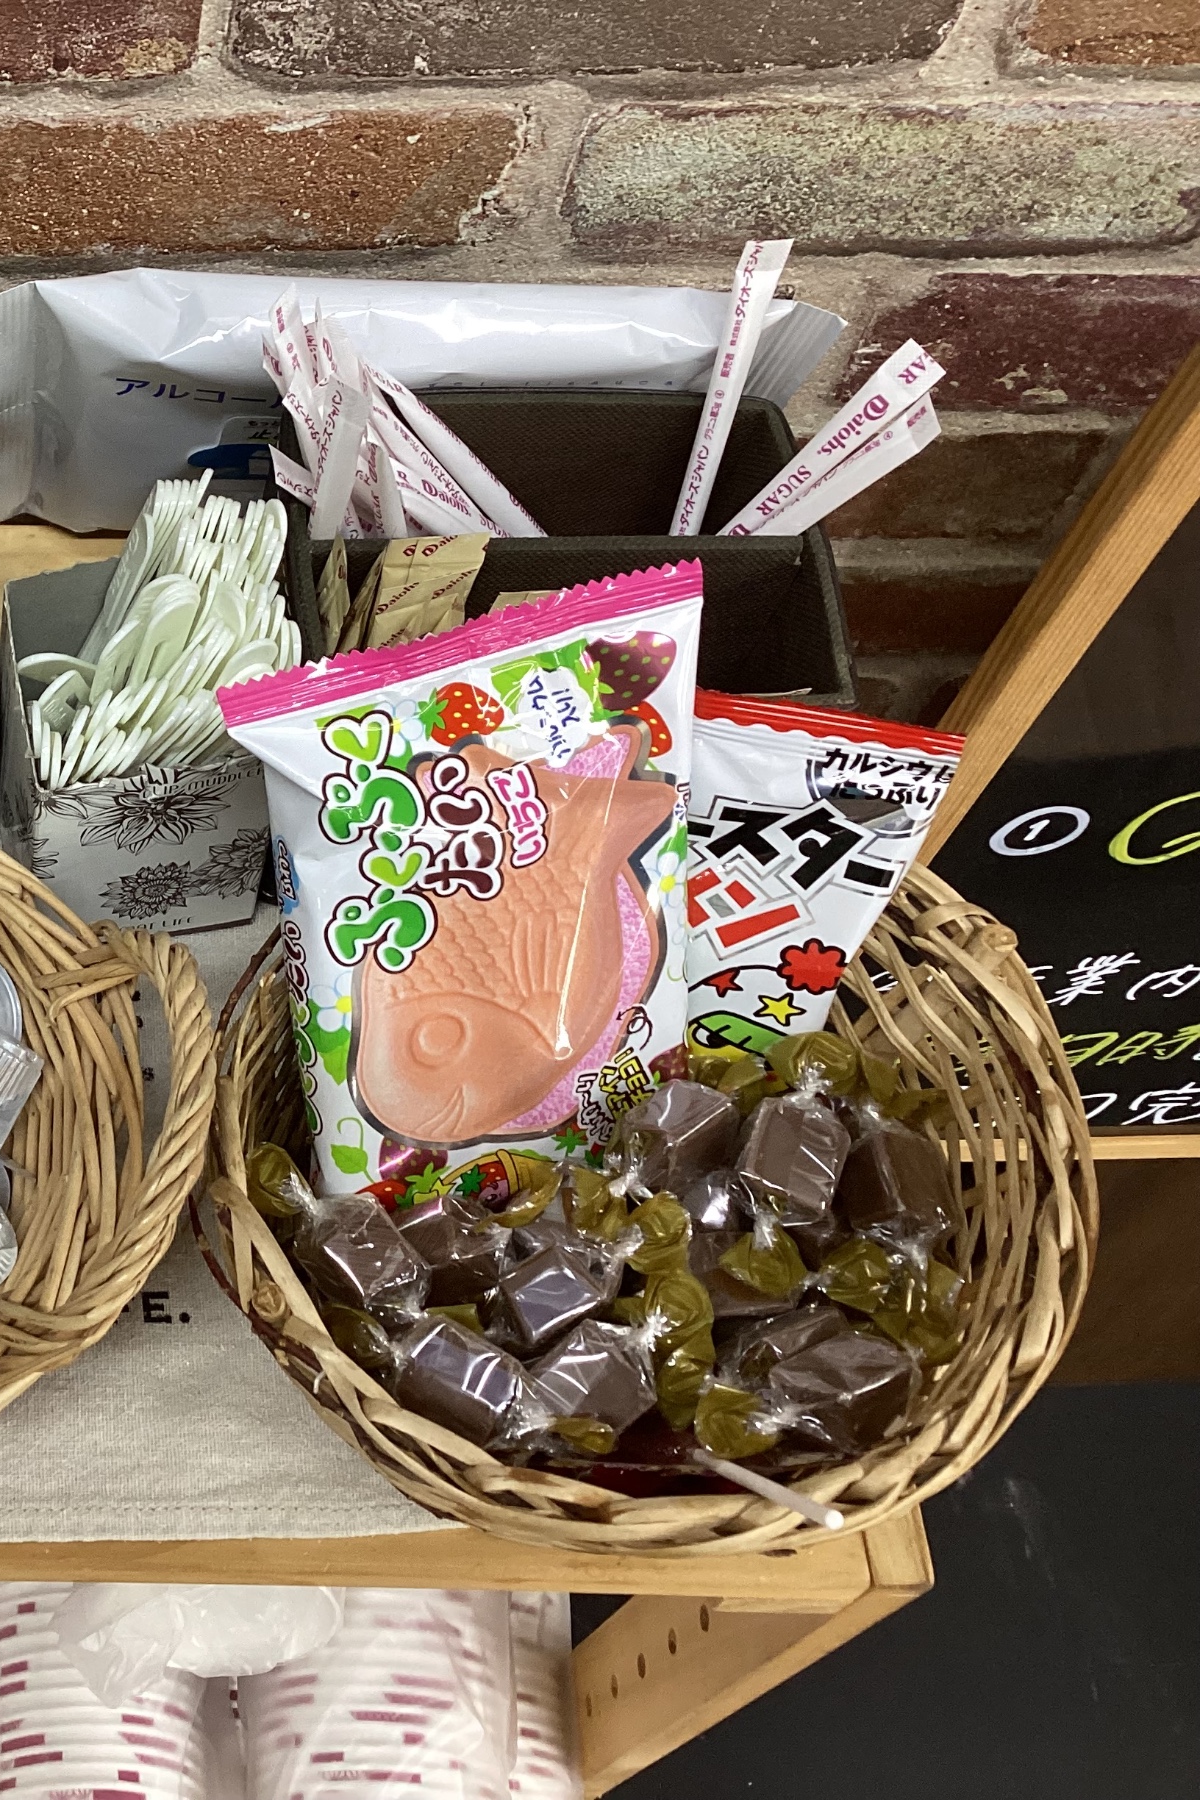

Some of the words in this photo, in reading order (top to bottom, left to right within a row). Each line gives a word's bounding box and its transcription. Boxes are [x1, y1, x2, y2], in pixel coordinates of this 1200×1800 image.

[755, 464, 813, 516] SUGAR
[316, 708, 439, 975] ぷくぷく
[421, 752, 505, 902] たい
[490, 764, 549, 868] いちご
